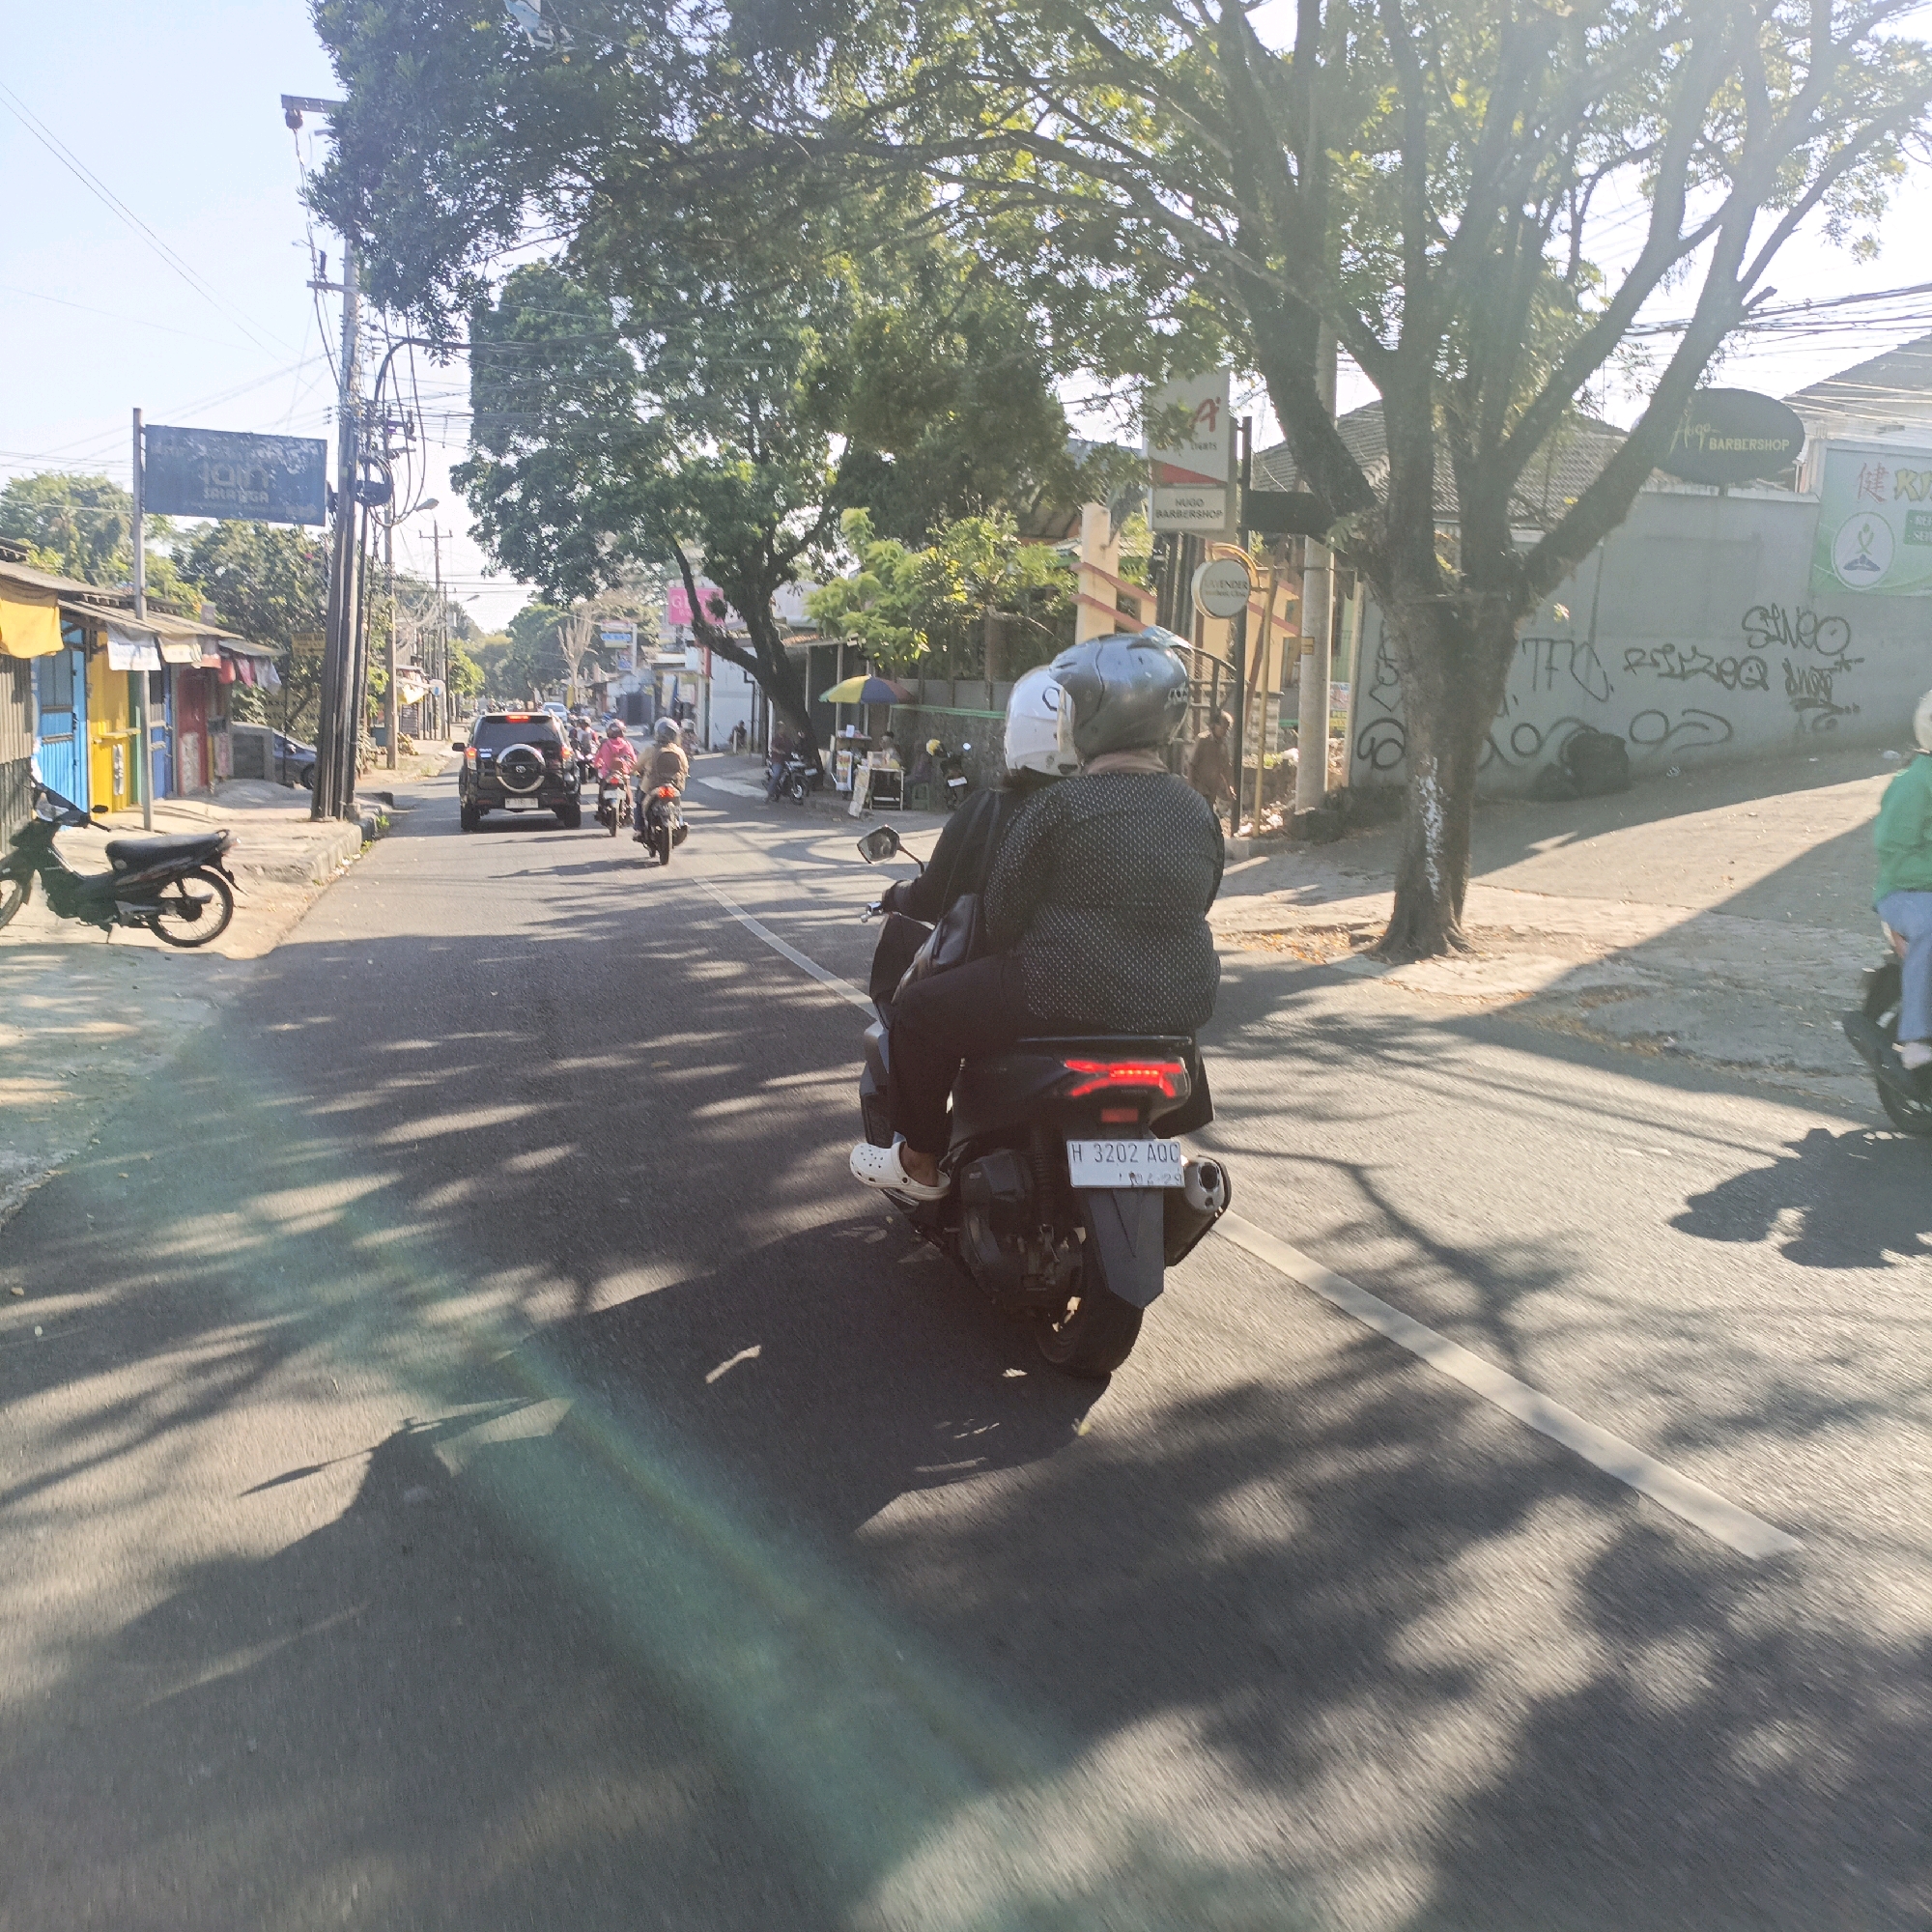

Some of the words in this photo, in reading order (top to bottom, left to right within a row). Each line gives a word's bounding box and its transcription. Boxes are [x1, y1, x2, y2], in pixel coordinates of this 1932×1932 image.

[1708, 437, 1791, 452] BARBERSHOP
[1858, 462, 1889, 504] 健
[1175, 497, 1206, 508] HUGO
[1155, 509, 1224, 520] BARBERSHOP
[1071, 1144, 1083, 1163] H
[1094, 1144, 1139, 1164] 3202
